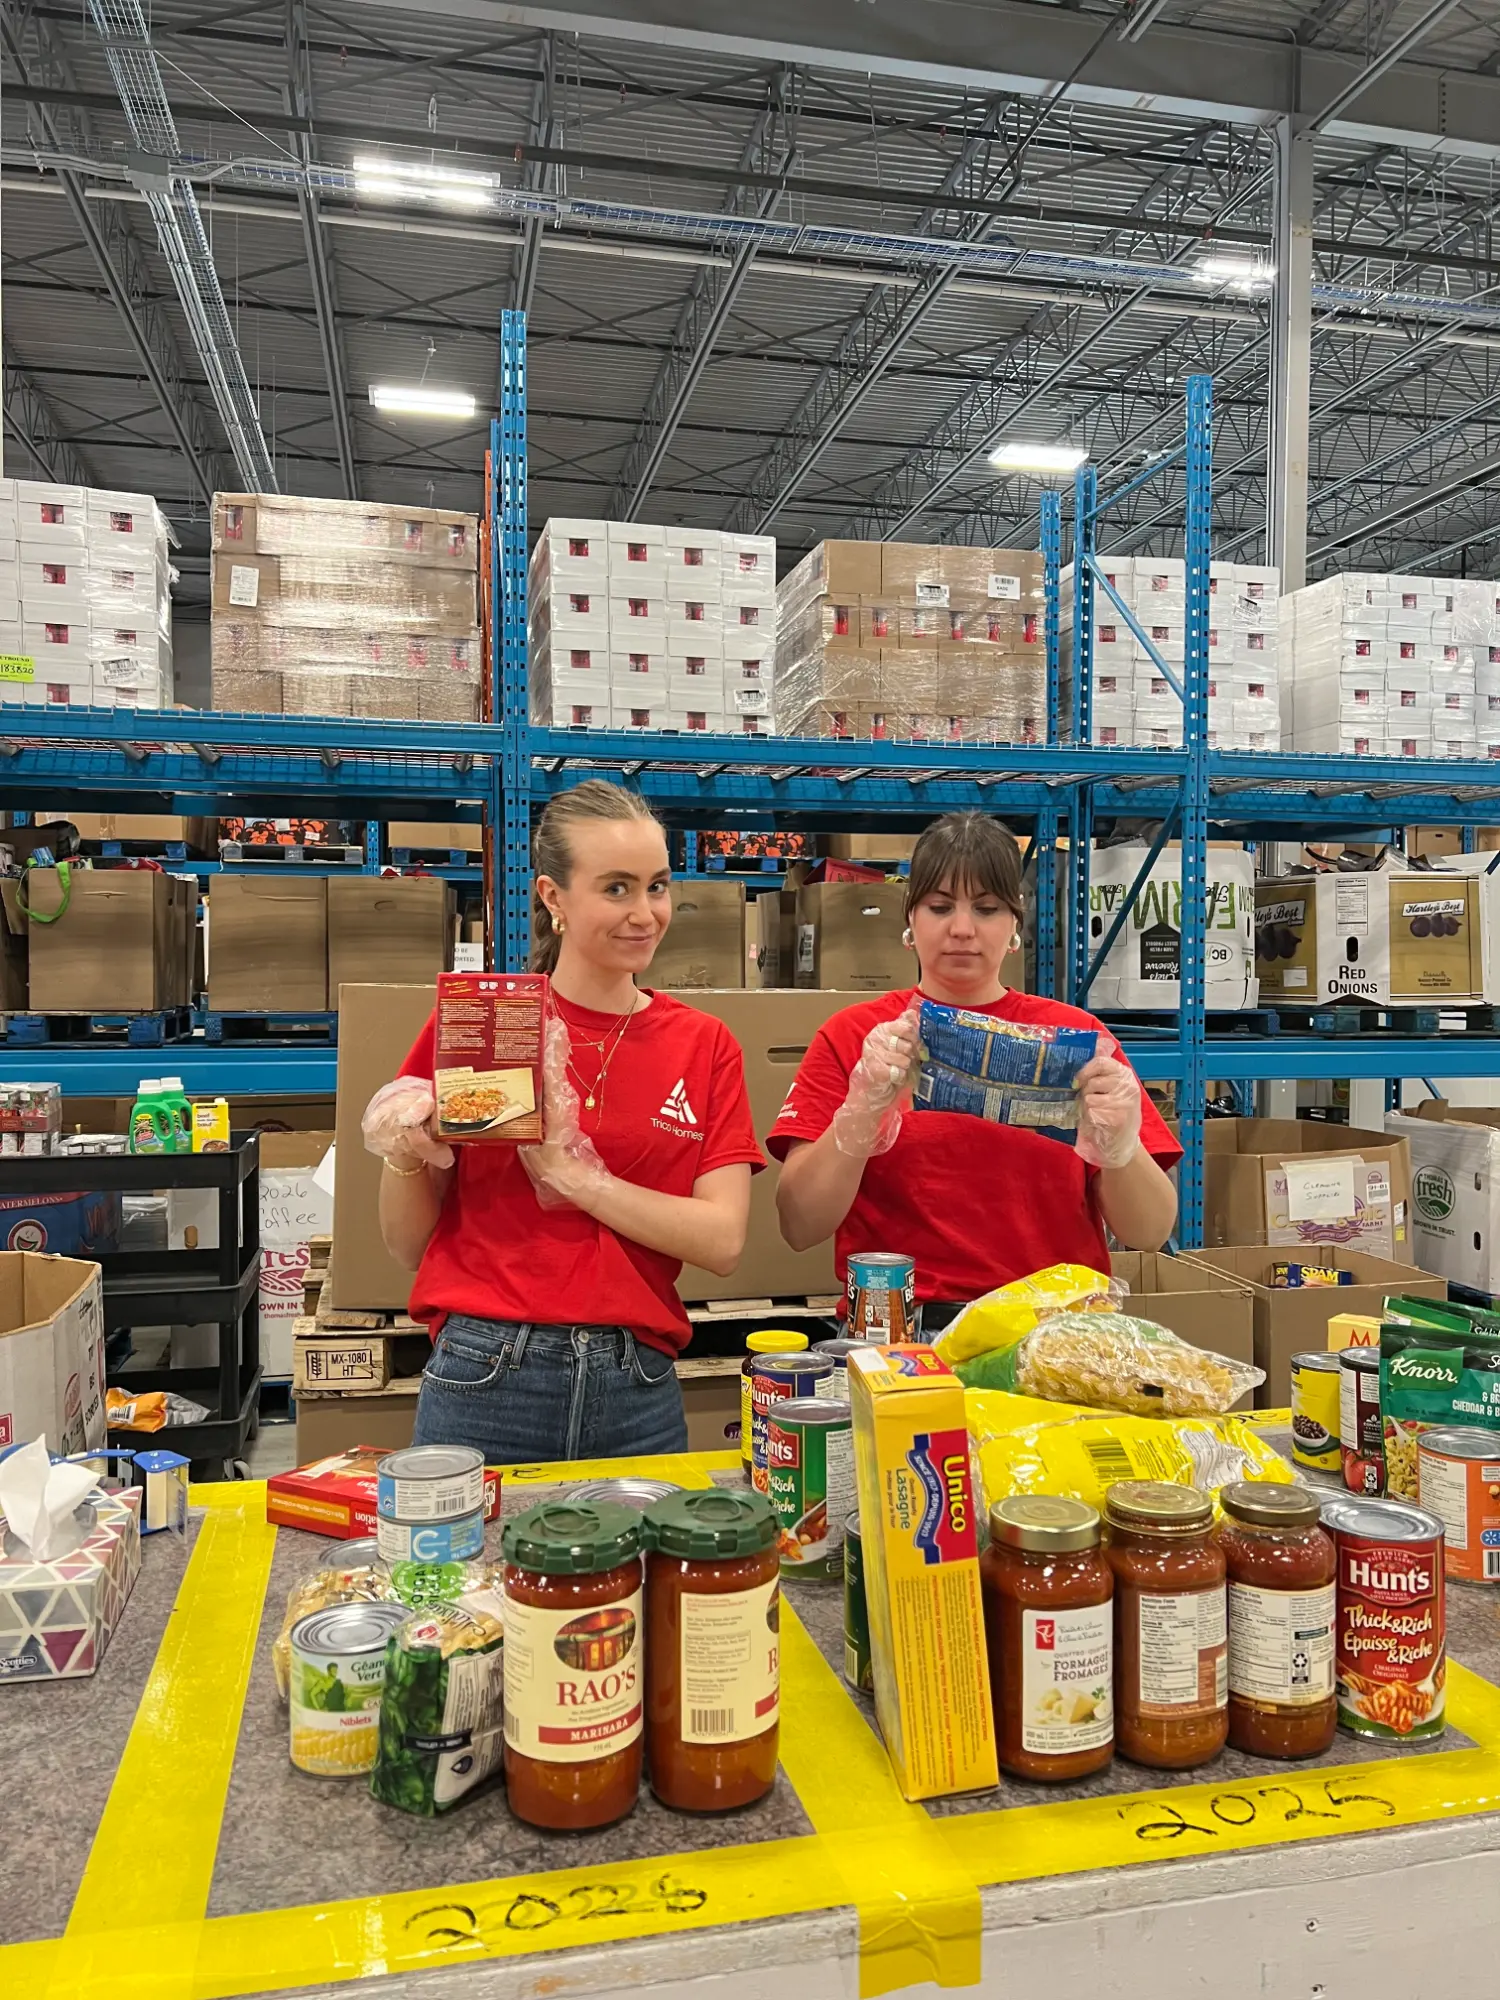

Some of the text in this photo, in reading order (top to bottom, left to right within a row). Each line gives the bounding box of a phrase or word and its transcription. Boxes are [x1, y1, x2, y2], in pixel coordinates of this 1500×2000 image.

[1274, 904, 1299, 920] Best
[1406, 901, 1460, 914] Hartley's Best
[1145, 962, 1180, 973] Reserve
[1339, 965, 1366, 980] RED
[1328, 980, 1378, 994] ONIONS
[650, 1118, 705, 1141] Trico Homes
[260, 1182, 307, 1201] 2026
[1417, 1174, 1452, 1206] fresh
[1300, 1266, 1340, 1283] SPAM
[260, 1302, 284, 1311] OWN
[331, 1352, 366, 1364] MX-1080
[342, 1365, 355, 1376] HT
[1452, 1400, 1485, 1416] CHEDDAR
[896, 1468, 910, 1530] Lasagne
[944, 1455, 968, 1532] Unico
[1350, 1559, 1430, 1594] Hunt's
[1344, 1628, 1398, 1658] Épaisse
[351, 1660, 386, 1674] Géan
[1054, 1651, 1108, 1670] FORMAGGI
[1374, 1664, 1407, 1672] ORIGINAL
[357, 1670, 382, 1682] Vert
[1054, 1662, 1108, 1681] FROMAGES
[556, 1663, 636, 1706] RAO'S
[340, 1715, 372, 1726] Niblets
[570, 1718, 628, 1742] MARINARA
[1117, 1775, 1396, 1840] 2025
